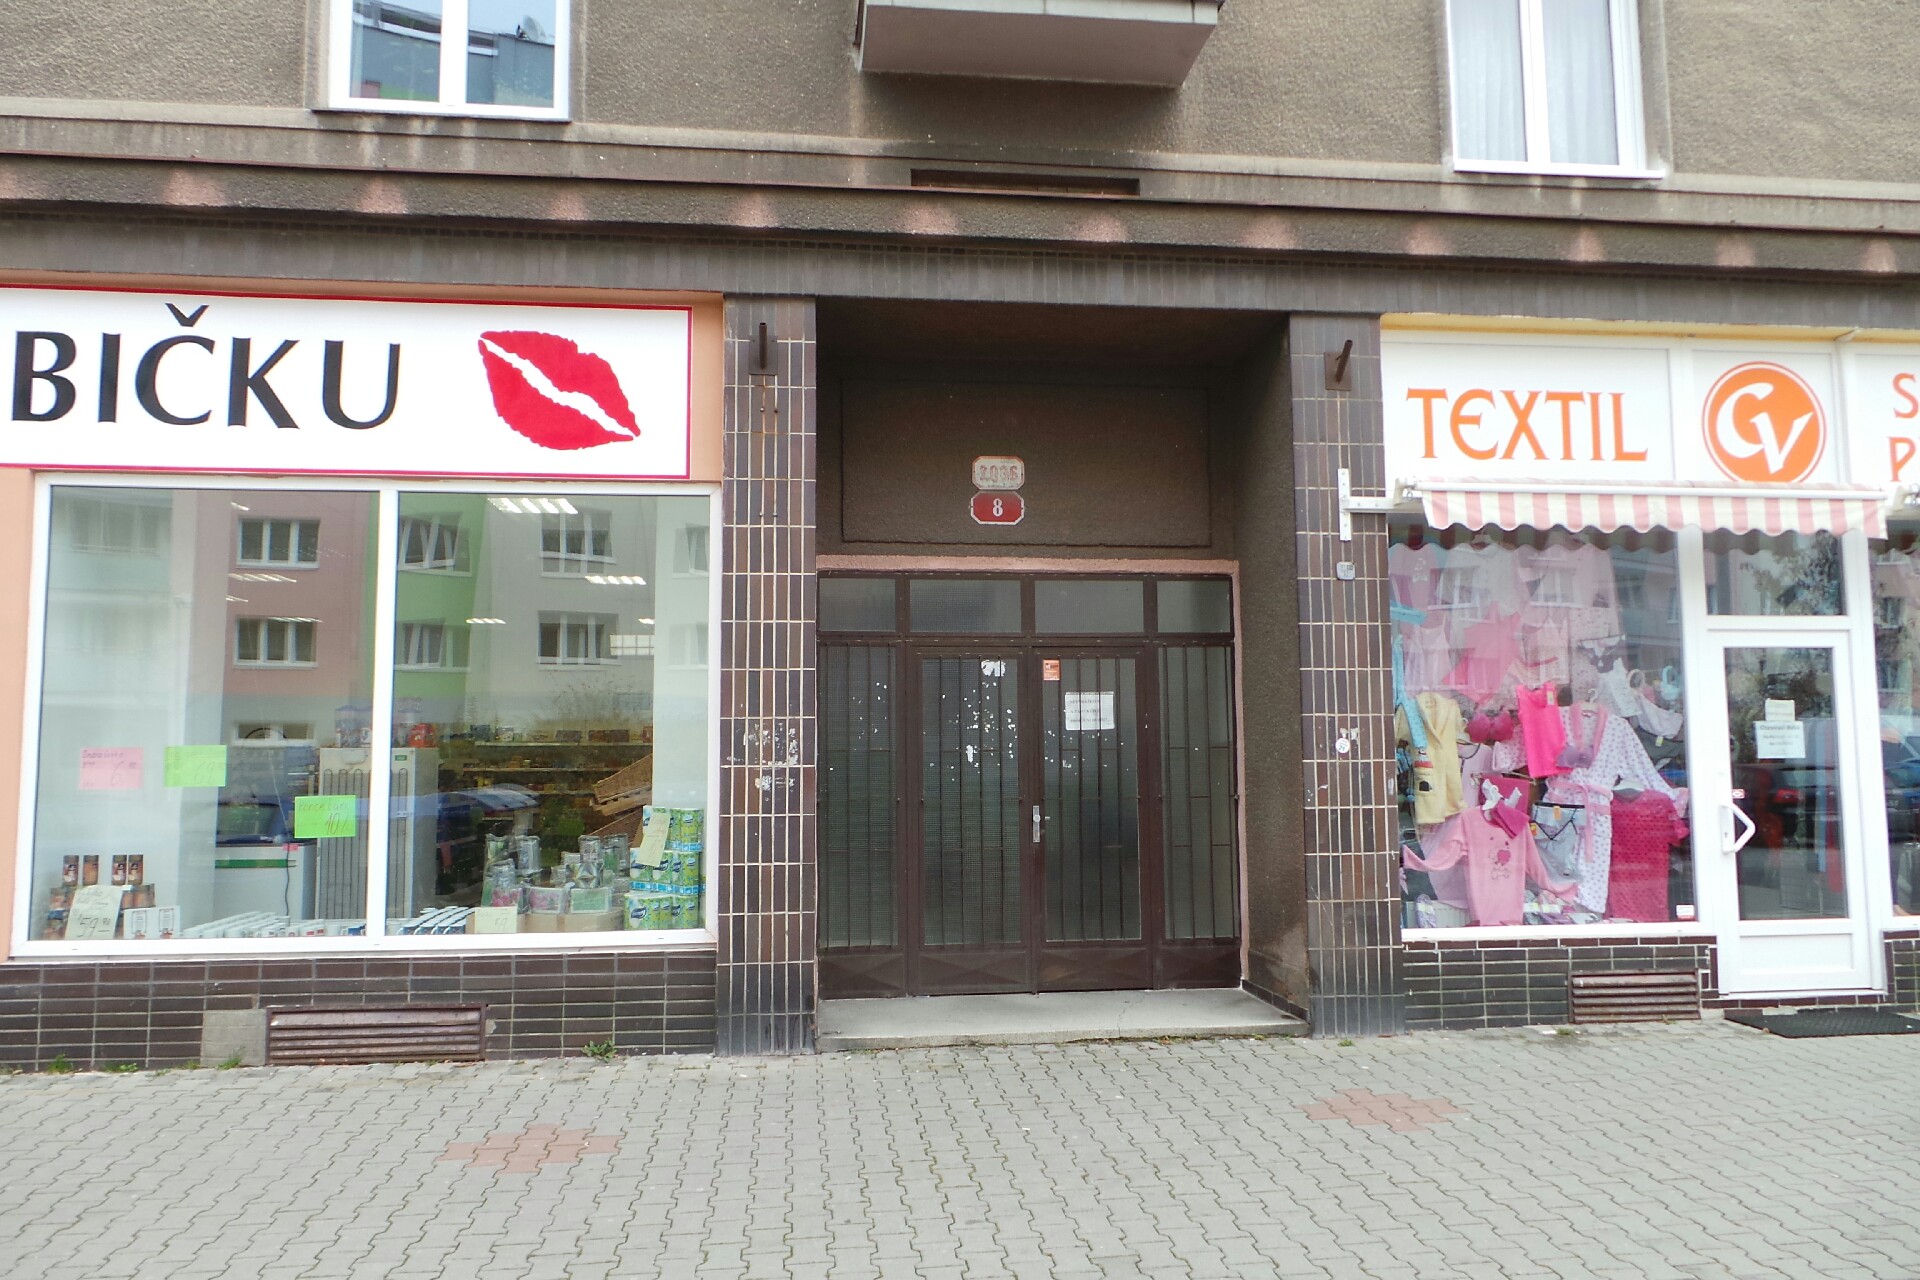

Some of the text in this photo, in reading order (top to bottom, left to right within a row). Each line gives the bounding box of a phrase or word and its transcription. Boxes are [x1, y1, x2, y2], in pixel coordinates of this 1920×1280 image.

[11, 302, 401, 430] BIČKU
[1406, 387, 1648, 462] TEXTIL
[992, 498, 1003, 517] 8
